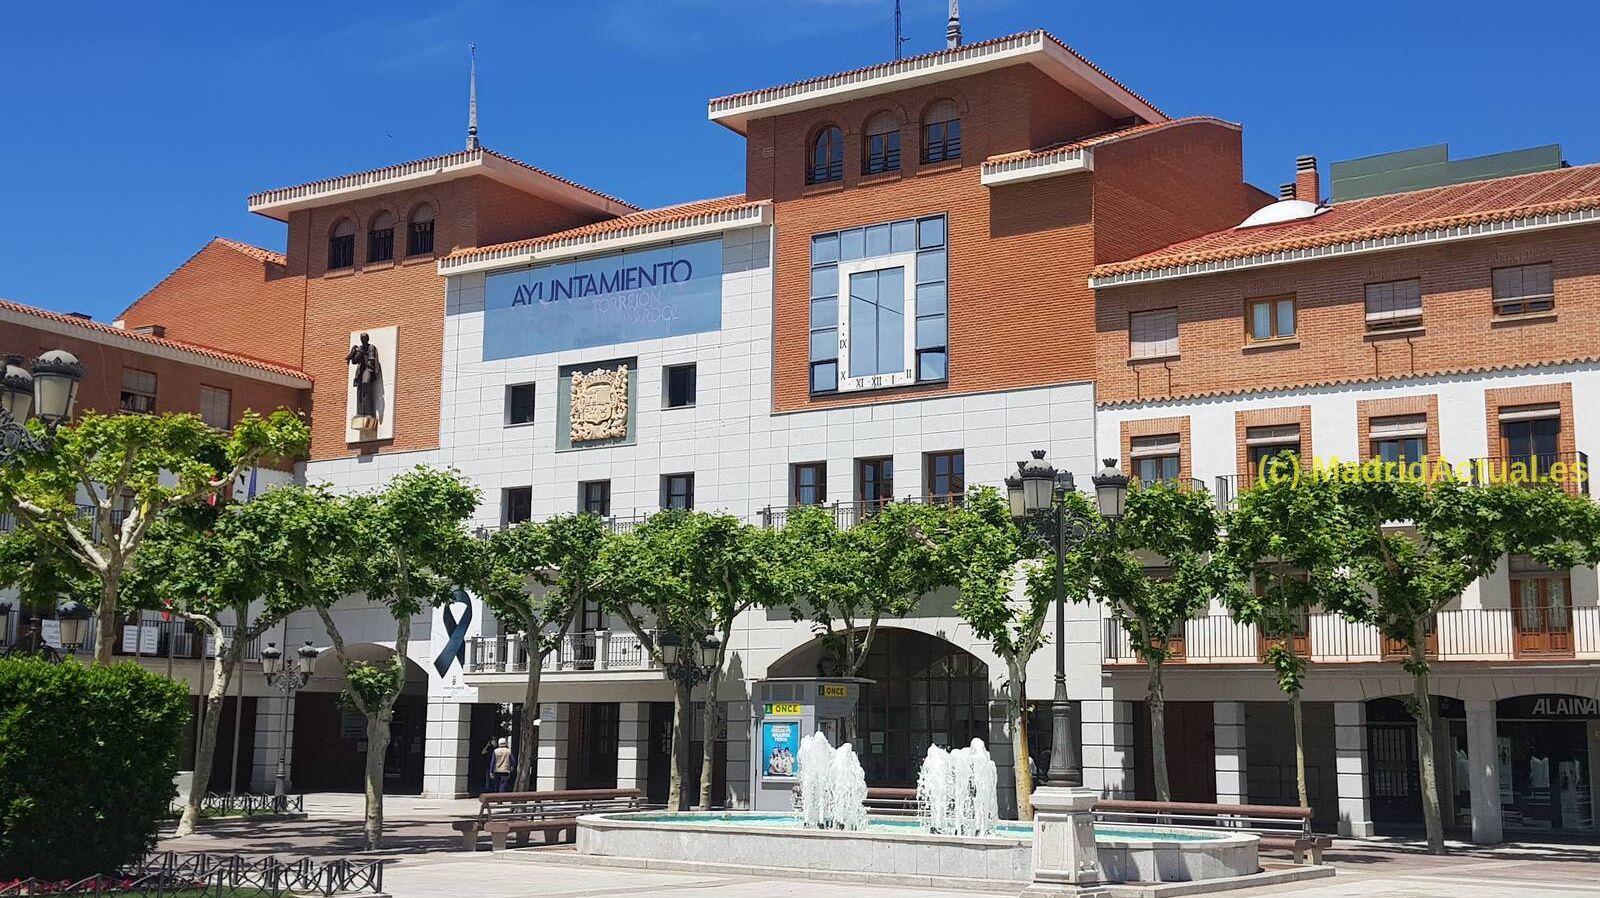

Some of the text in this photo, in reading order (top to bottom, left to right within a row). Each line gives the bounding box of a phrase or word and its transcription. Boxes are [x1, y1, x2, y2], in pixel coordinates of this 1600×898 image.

[511, 258, 693, 308] AYUNTAMIENTO
[826, 687, 844, 696] ONCE
[775, 704, 798, 713] ONCE
